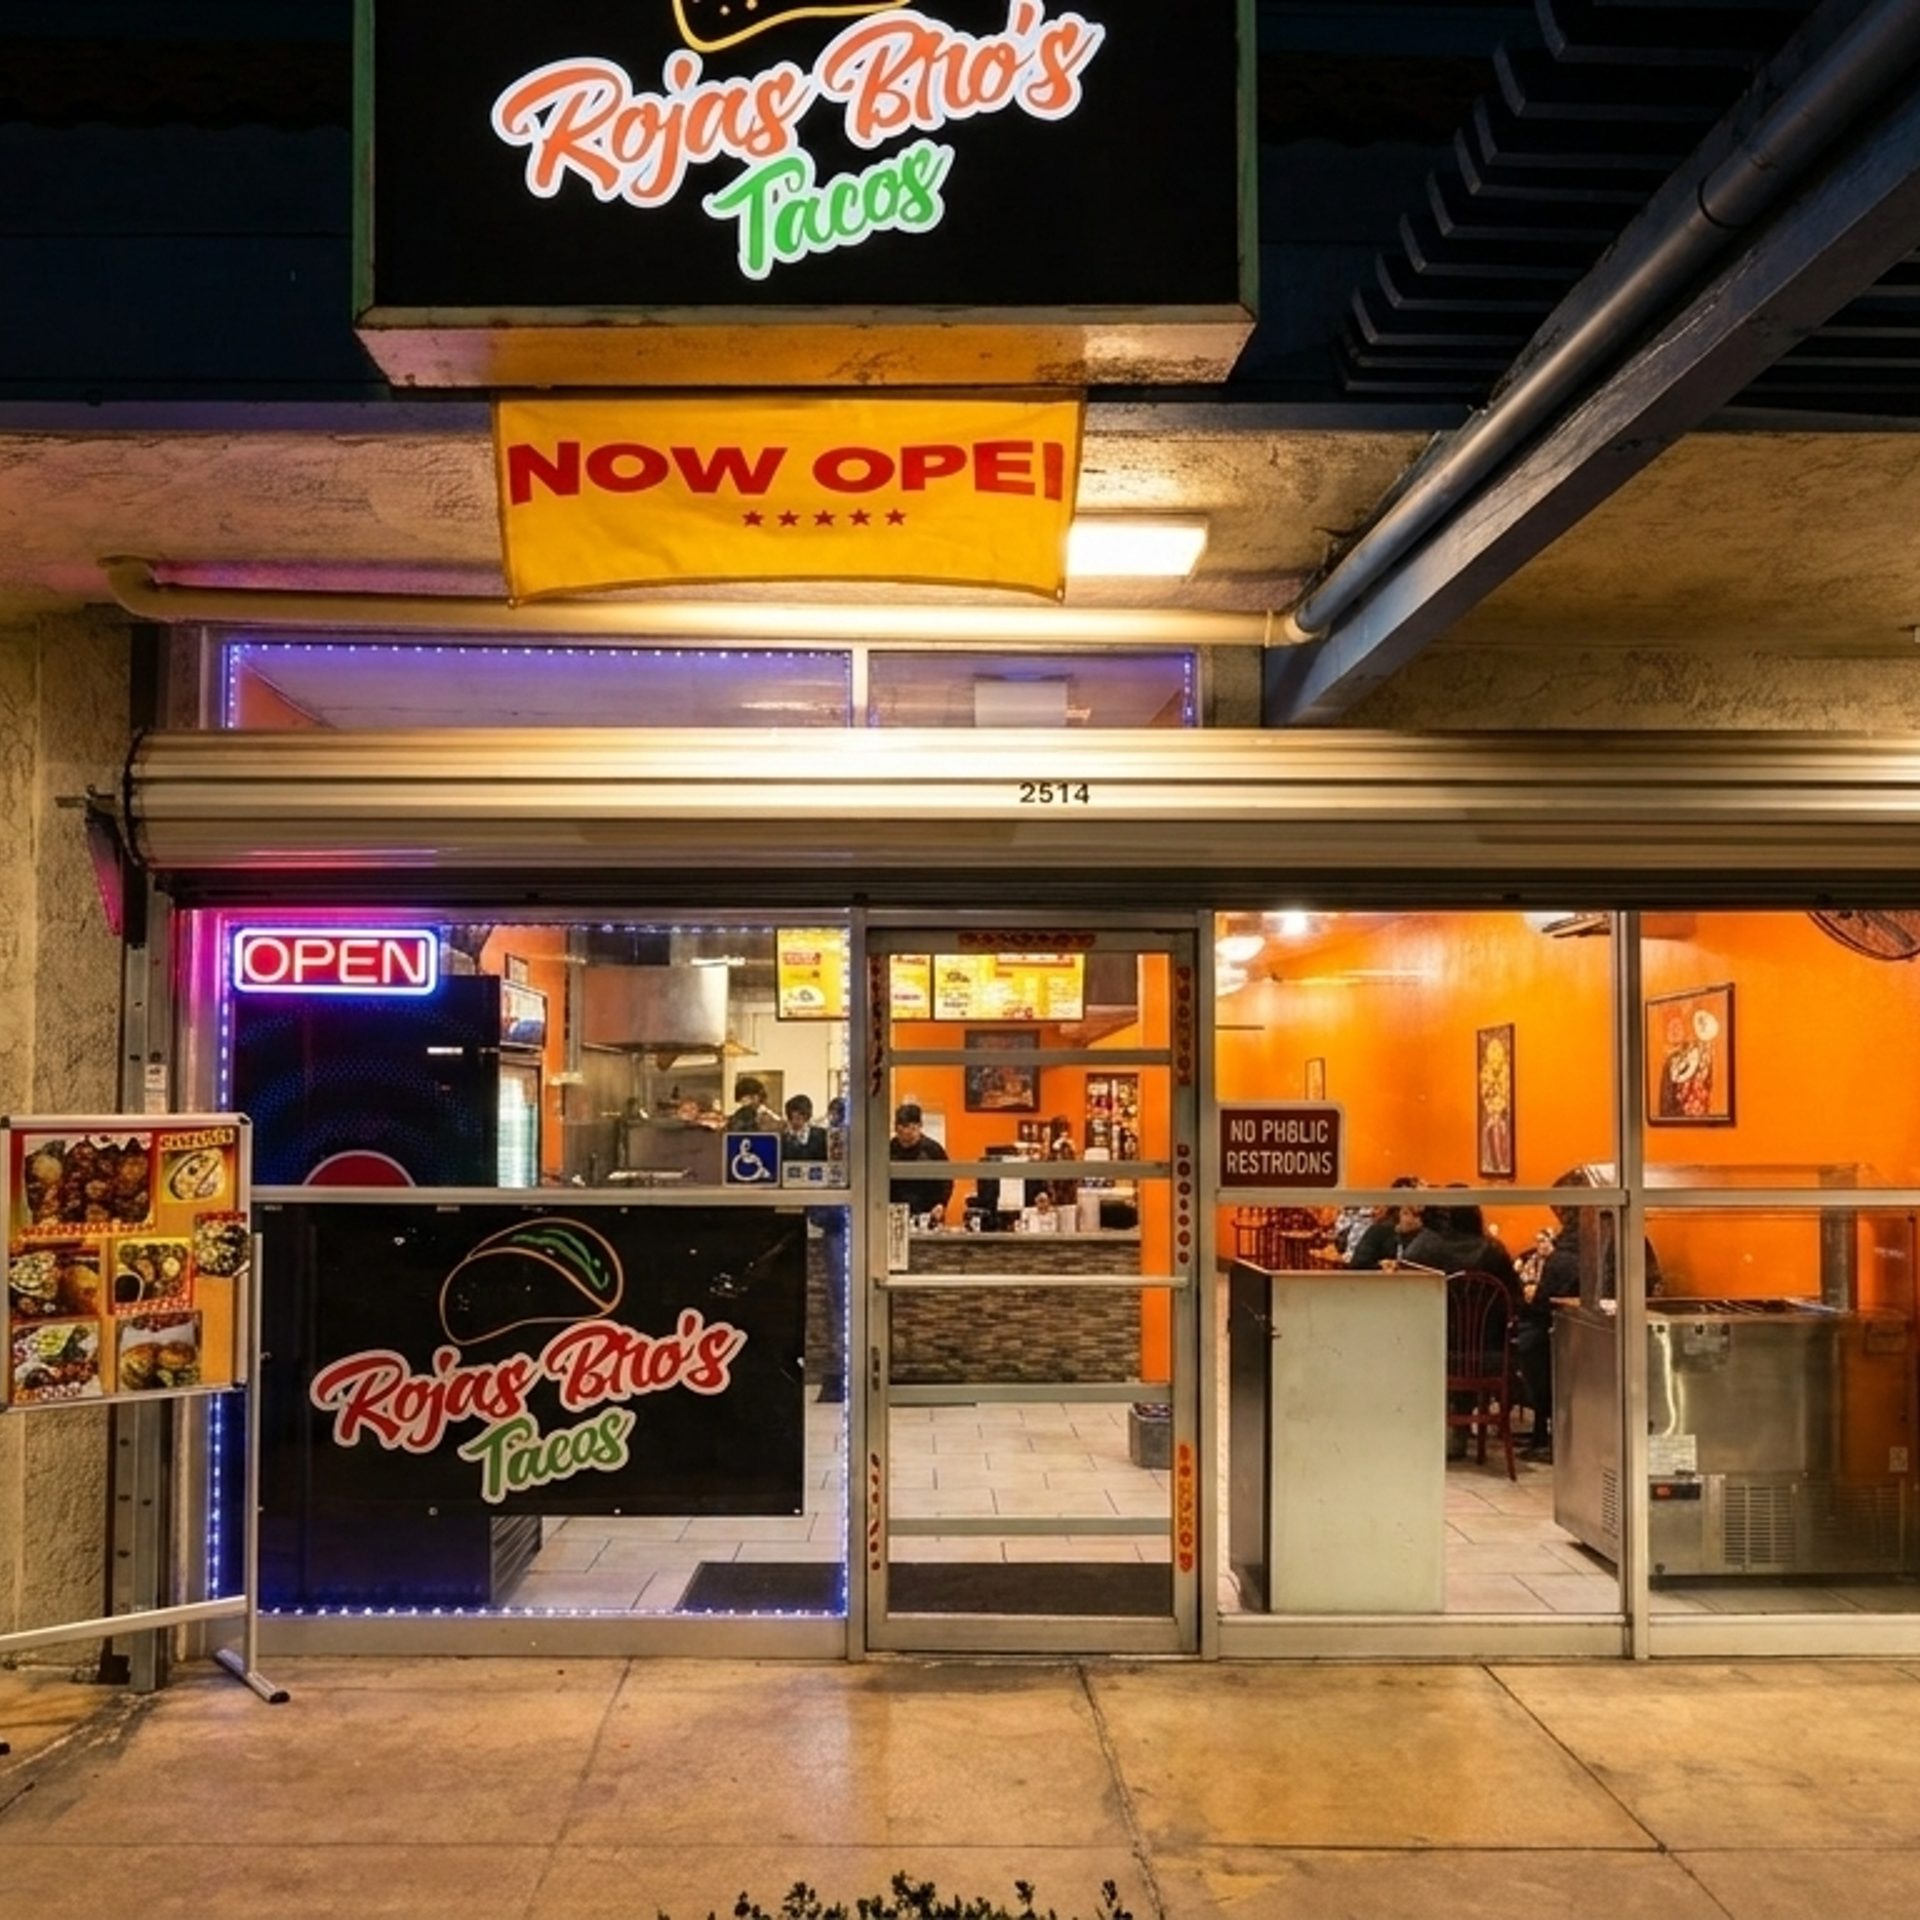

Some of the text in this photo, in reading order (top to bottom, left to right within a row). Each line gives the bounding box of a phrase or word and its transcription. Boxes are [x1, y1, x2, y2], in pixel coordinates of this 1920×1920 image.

[492, 50, 815, 207] Rojas
[703, 140, 954, 279] Tacos
[508, 441, 788, 504] NOW
[1019, 781, 1090, 804] 2514
[244, 937, 426, 984] OPEN
[1231, 1119, 1256, 1143] NO
[310, 1345, 545, 1454] Rojas
